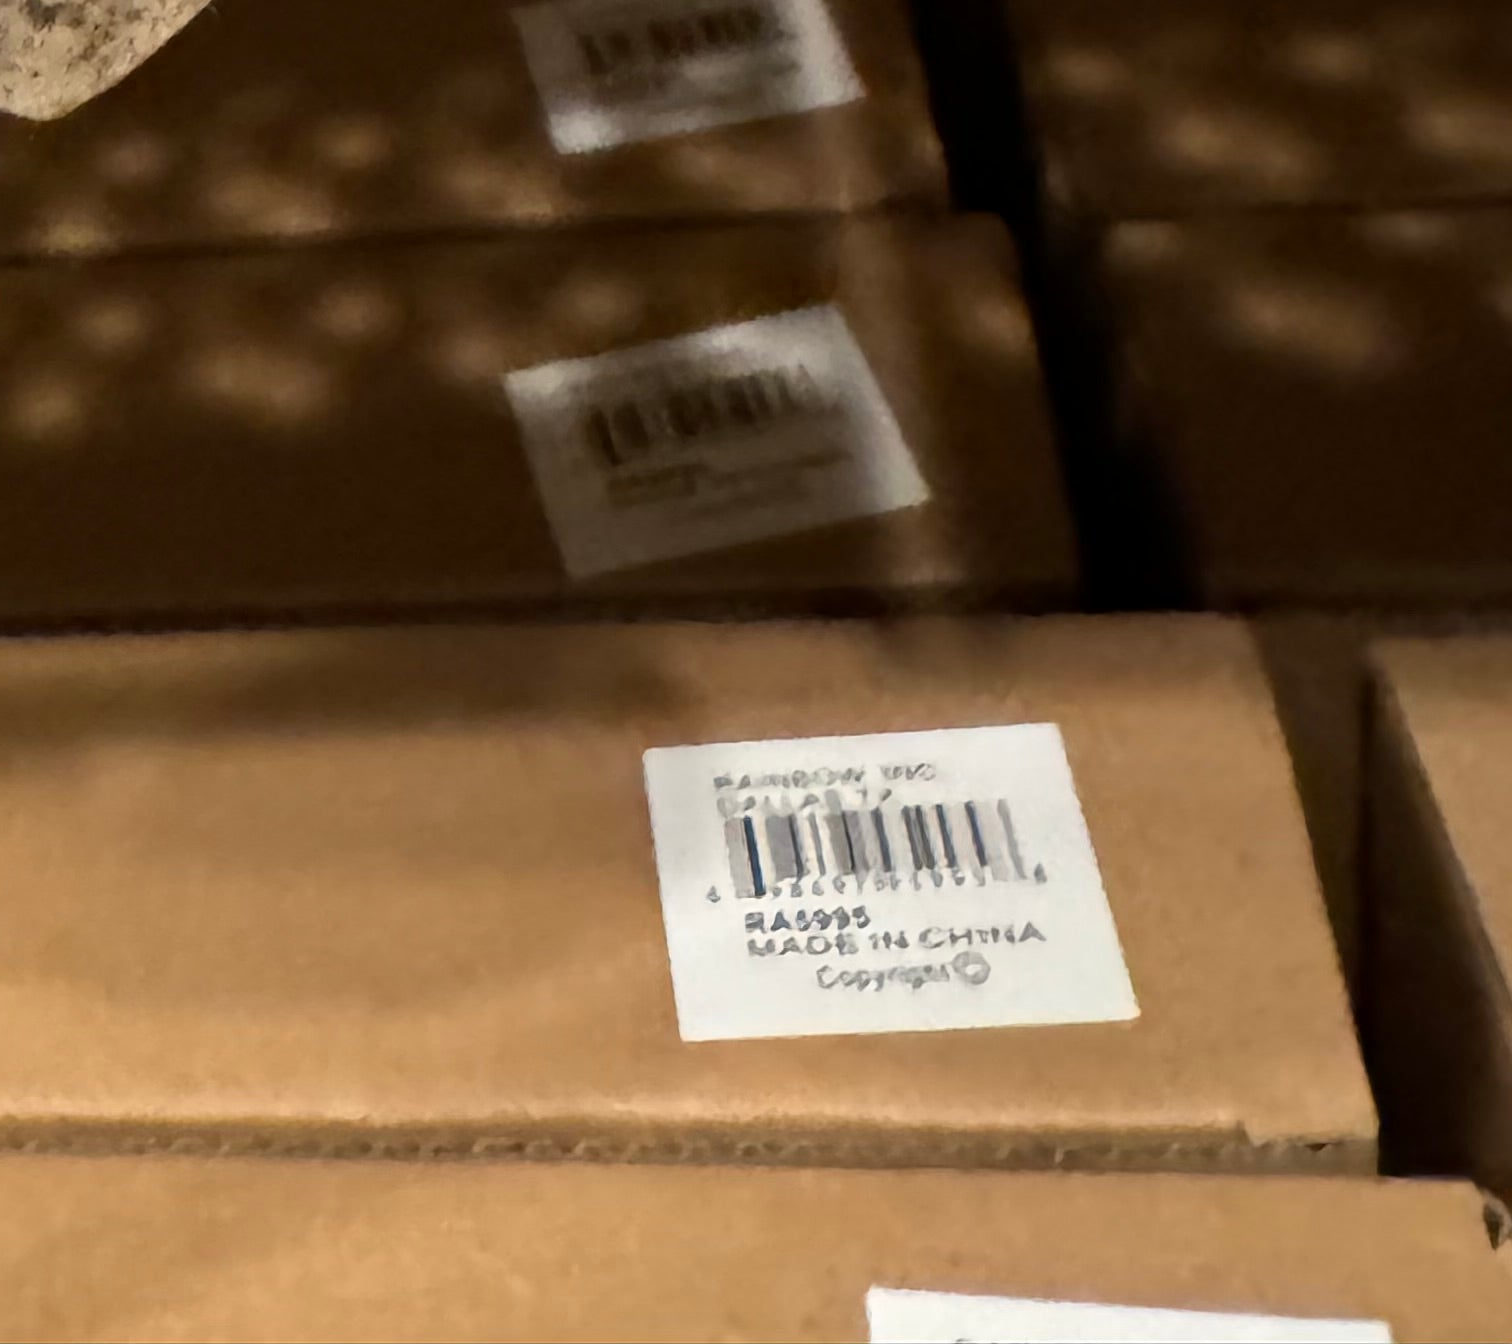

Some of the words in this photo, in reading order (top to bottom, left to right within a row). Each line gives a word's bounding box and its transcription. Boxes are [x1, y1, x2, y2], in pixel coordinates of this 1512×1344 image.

[746, 933, 860, 957] MADE
[869, 930, 910, 950] IN
[918, 921, 1047, 950] CHINA
